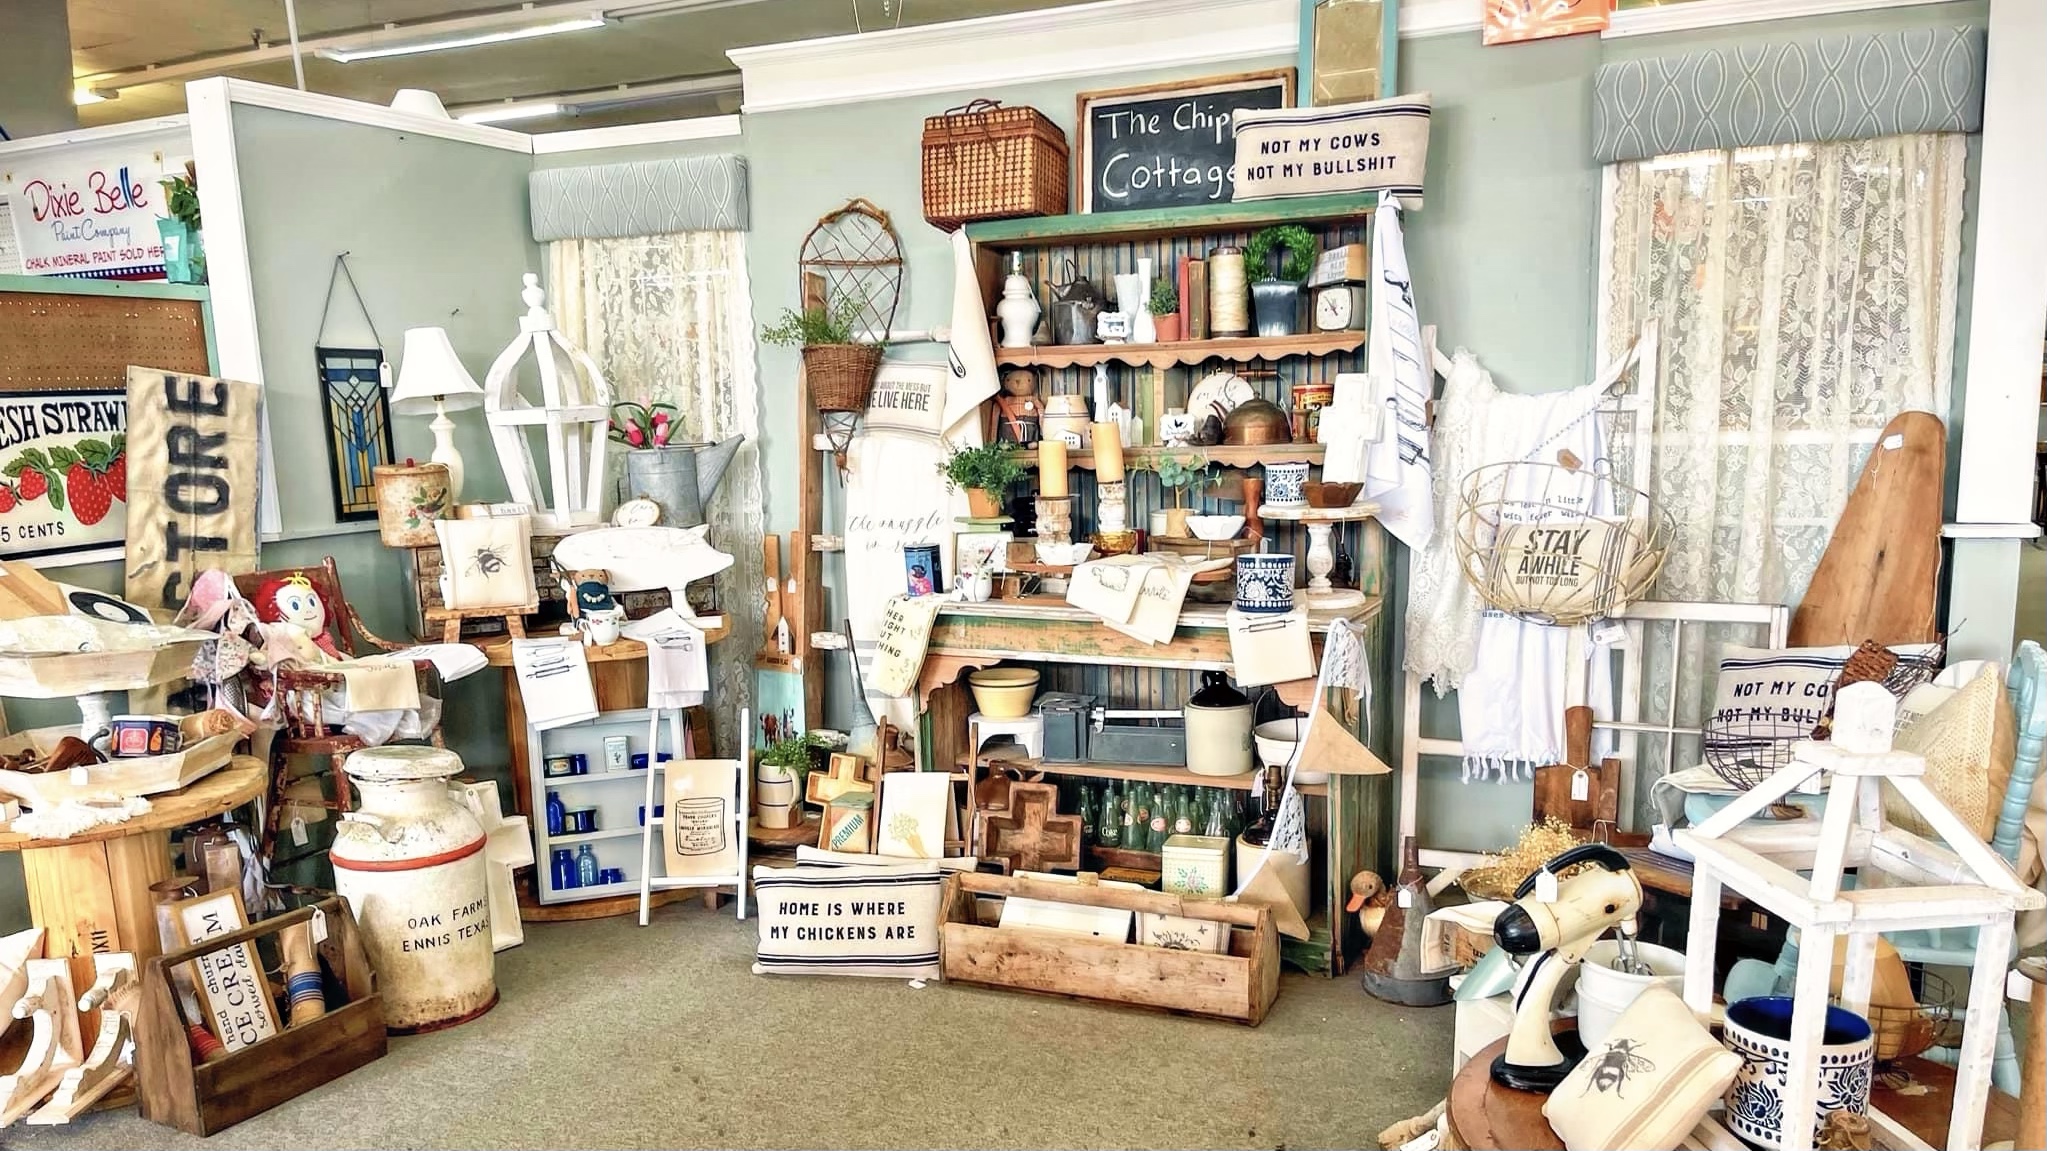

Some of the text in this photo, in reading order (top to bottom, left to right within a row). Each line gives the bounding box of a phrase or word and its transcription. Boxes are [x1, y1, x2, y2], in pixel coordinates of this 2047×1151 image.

[1098, 101, 1230, 144] The Chip
[1261, 133, 1381, 154] NOT MY COWS
[1247, 156, 1396, 180] NOT MY BULLSHIT
[24, 167, 148, 221] Dixie Belle
[51, 218, 131, 247] Paint Company
[26, 255, 49, 269] CHALK
[52, 251, 91, 268] MINERAL
[92, 248, 117, 264] PAINT
[119, 246, 145, 262] SOLD
[878, 391, 899, 408] LIVE
[901, 391, 930, 412] HERE
[41, 401, 127, 435] STRAW
[162, 376, 230, 610] TORE
[19, 520, 65, 538] CENTS
[1524, 529, 1591, 555] STAY
[1560, 577, 1578, 587] LONG
[880, 630, 893, 641] UT
[884, 620, 906, 634] IGHT
[878, 642, 901, 658] HING
[1733, 681, 1829, 698] NOT MY CO
[1716, 708, 1742, 723] NOT
[1750, 707, 1772, 721] MY
[832, 814, 864, 849] PREMIUM
[779, 902, 906, 916] HOME IS WHERE
[408, 914, 441, 929] OAK
[402, 933, 450, 952] ENNIS
[770, 926, 915, 940] MY CHICKENS ARE
[202, 911, 257, 1045] CE CREM
[242, 975, 268, 1029] served
[217, 1009, 235, 1045] hand
